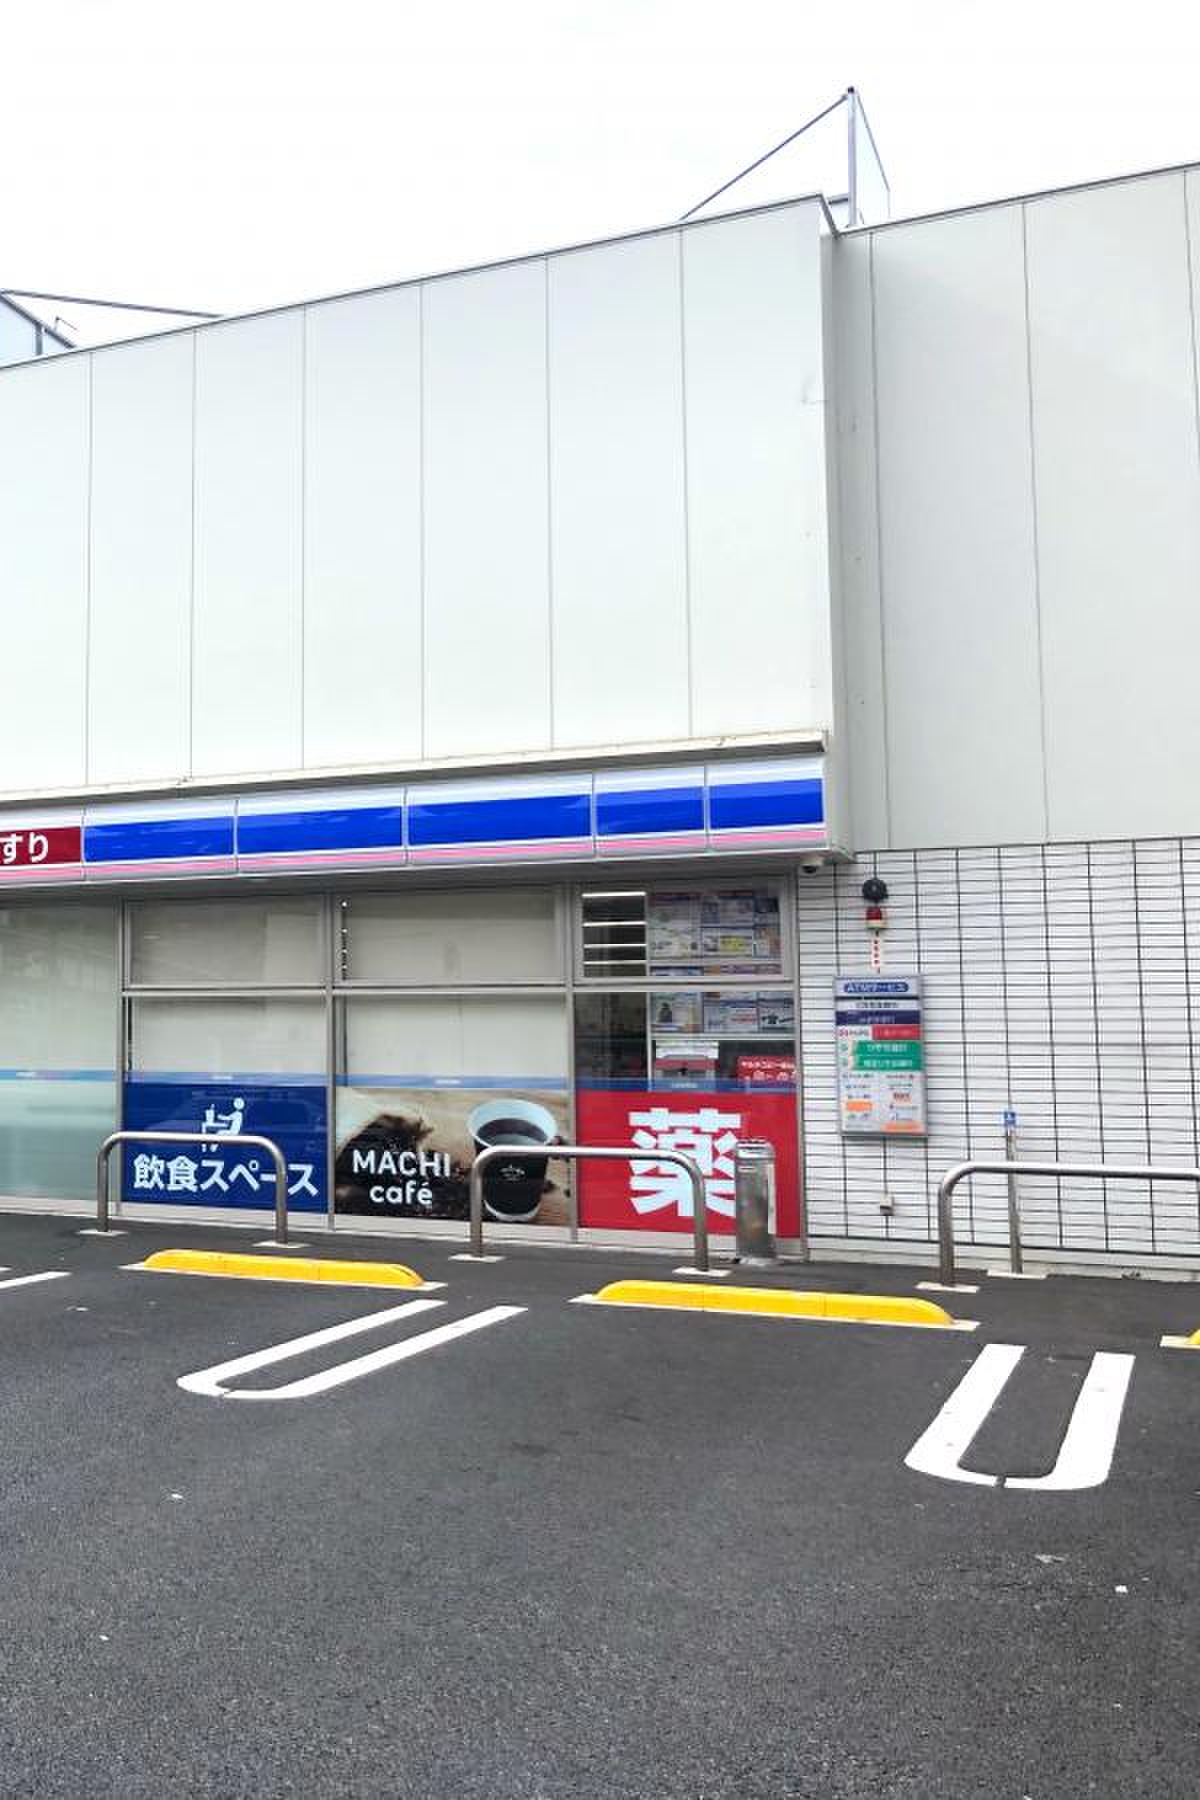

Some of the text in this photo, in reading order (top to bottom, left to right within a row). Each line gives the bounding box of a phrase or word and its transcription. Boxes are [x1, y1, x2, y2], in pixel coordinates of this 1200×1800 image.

[133, 1153, 319, 1197] 飲食スペース
[352, 1150, 451, 1178] MACHI
[628, 1107, 742, 1218] 薬
[369, 1180, 433, 1206] café
